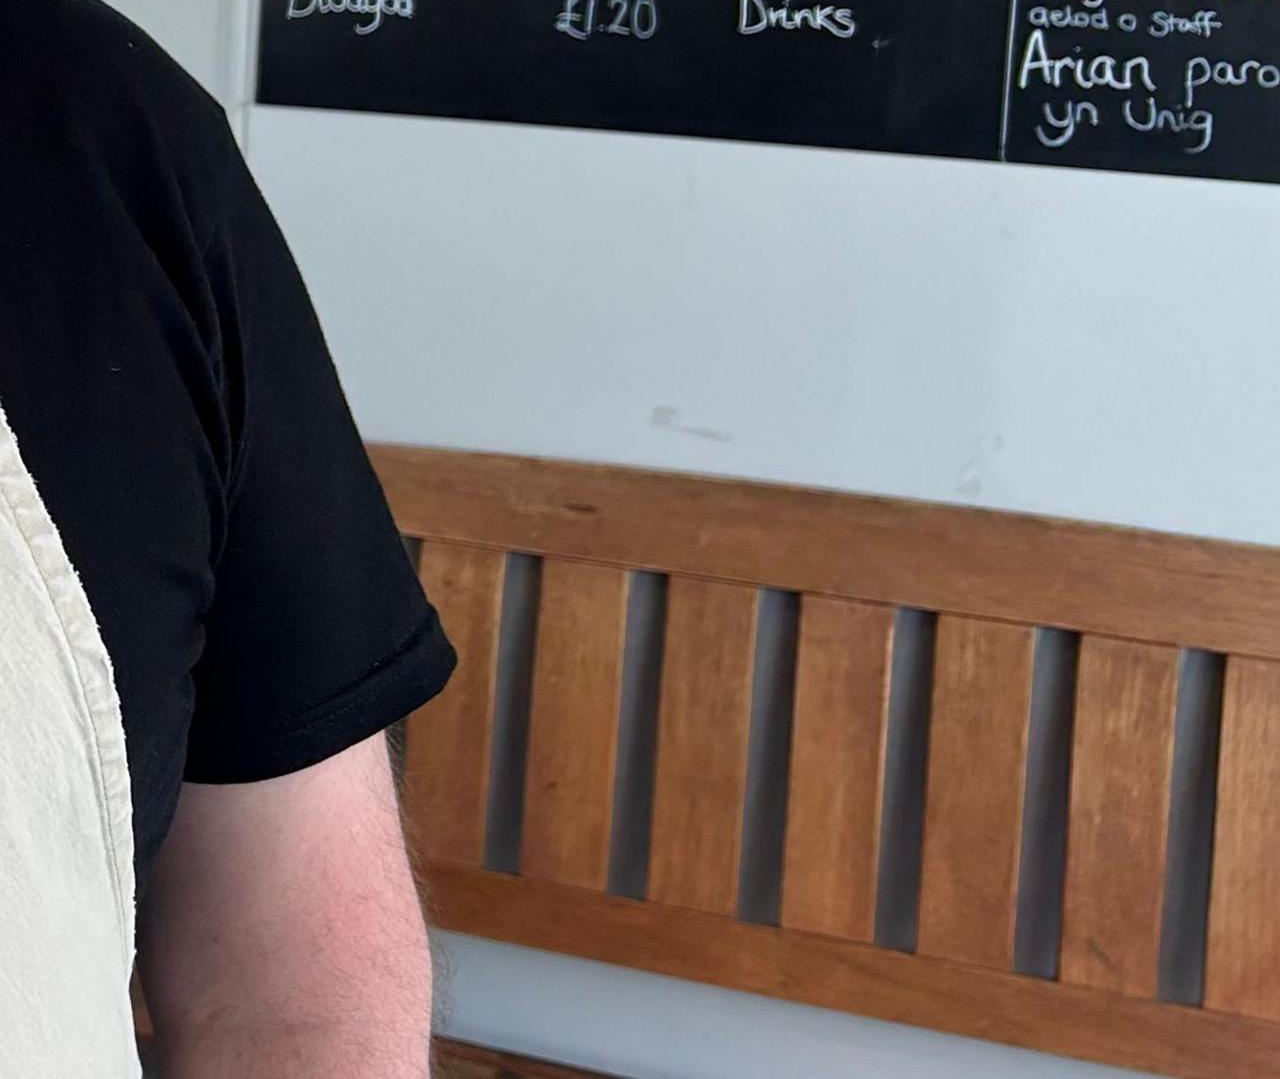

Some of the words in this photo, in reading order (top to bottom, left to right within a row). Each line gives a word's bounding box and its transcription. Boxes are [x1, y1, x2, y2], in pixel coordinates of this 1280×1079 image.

[1030, 6, 1108, 30] aelod
[1117, 14, 1137, 32] o
[1018, 29, 1156, 91] Arian
[1034, 100, 1099, 147] yn
[1123, 96, 1213, 153] Unig
